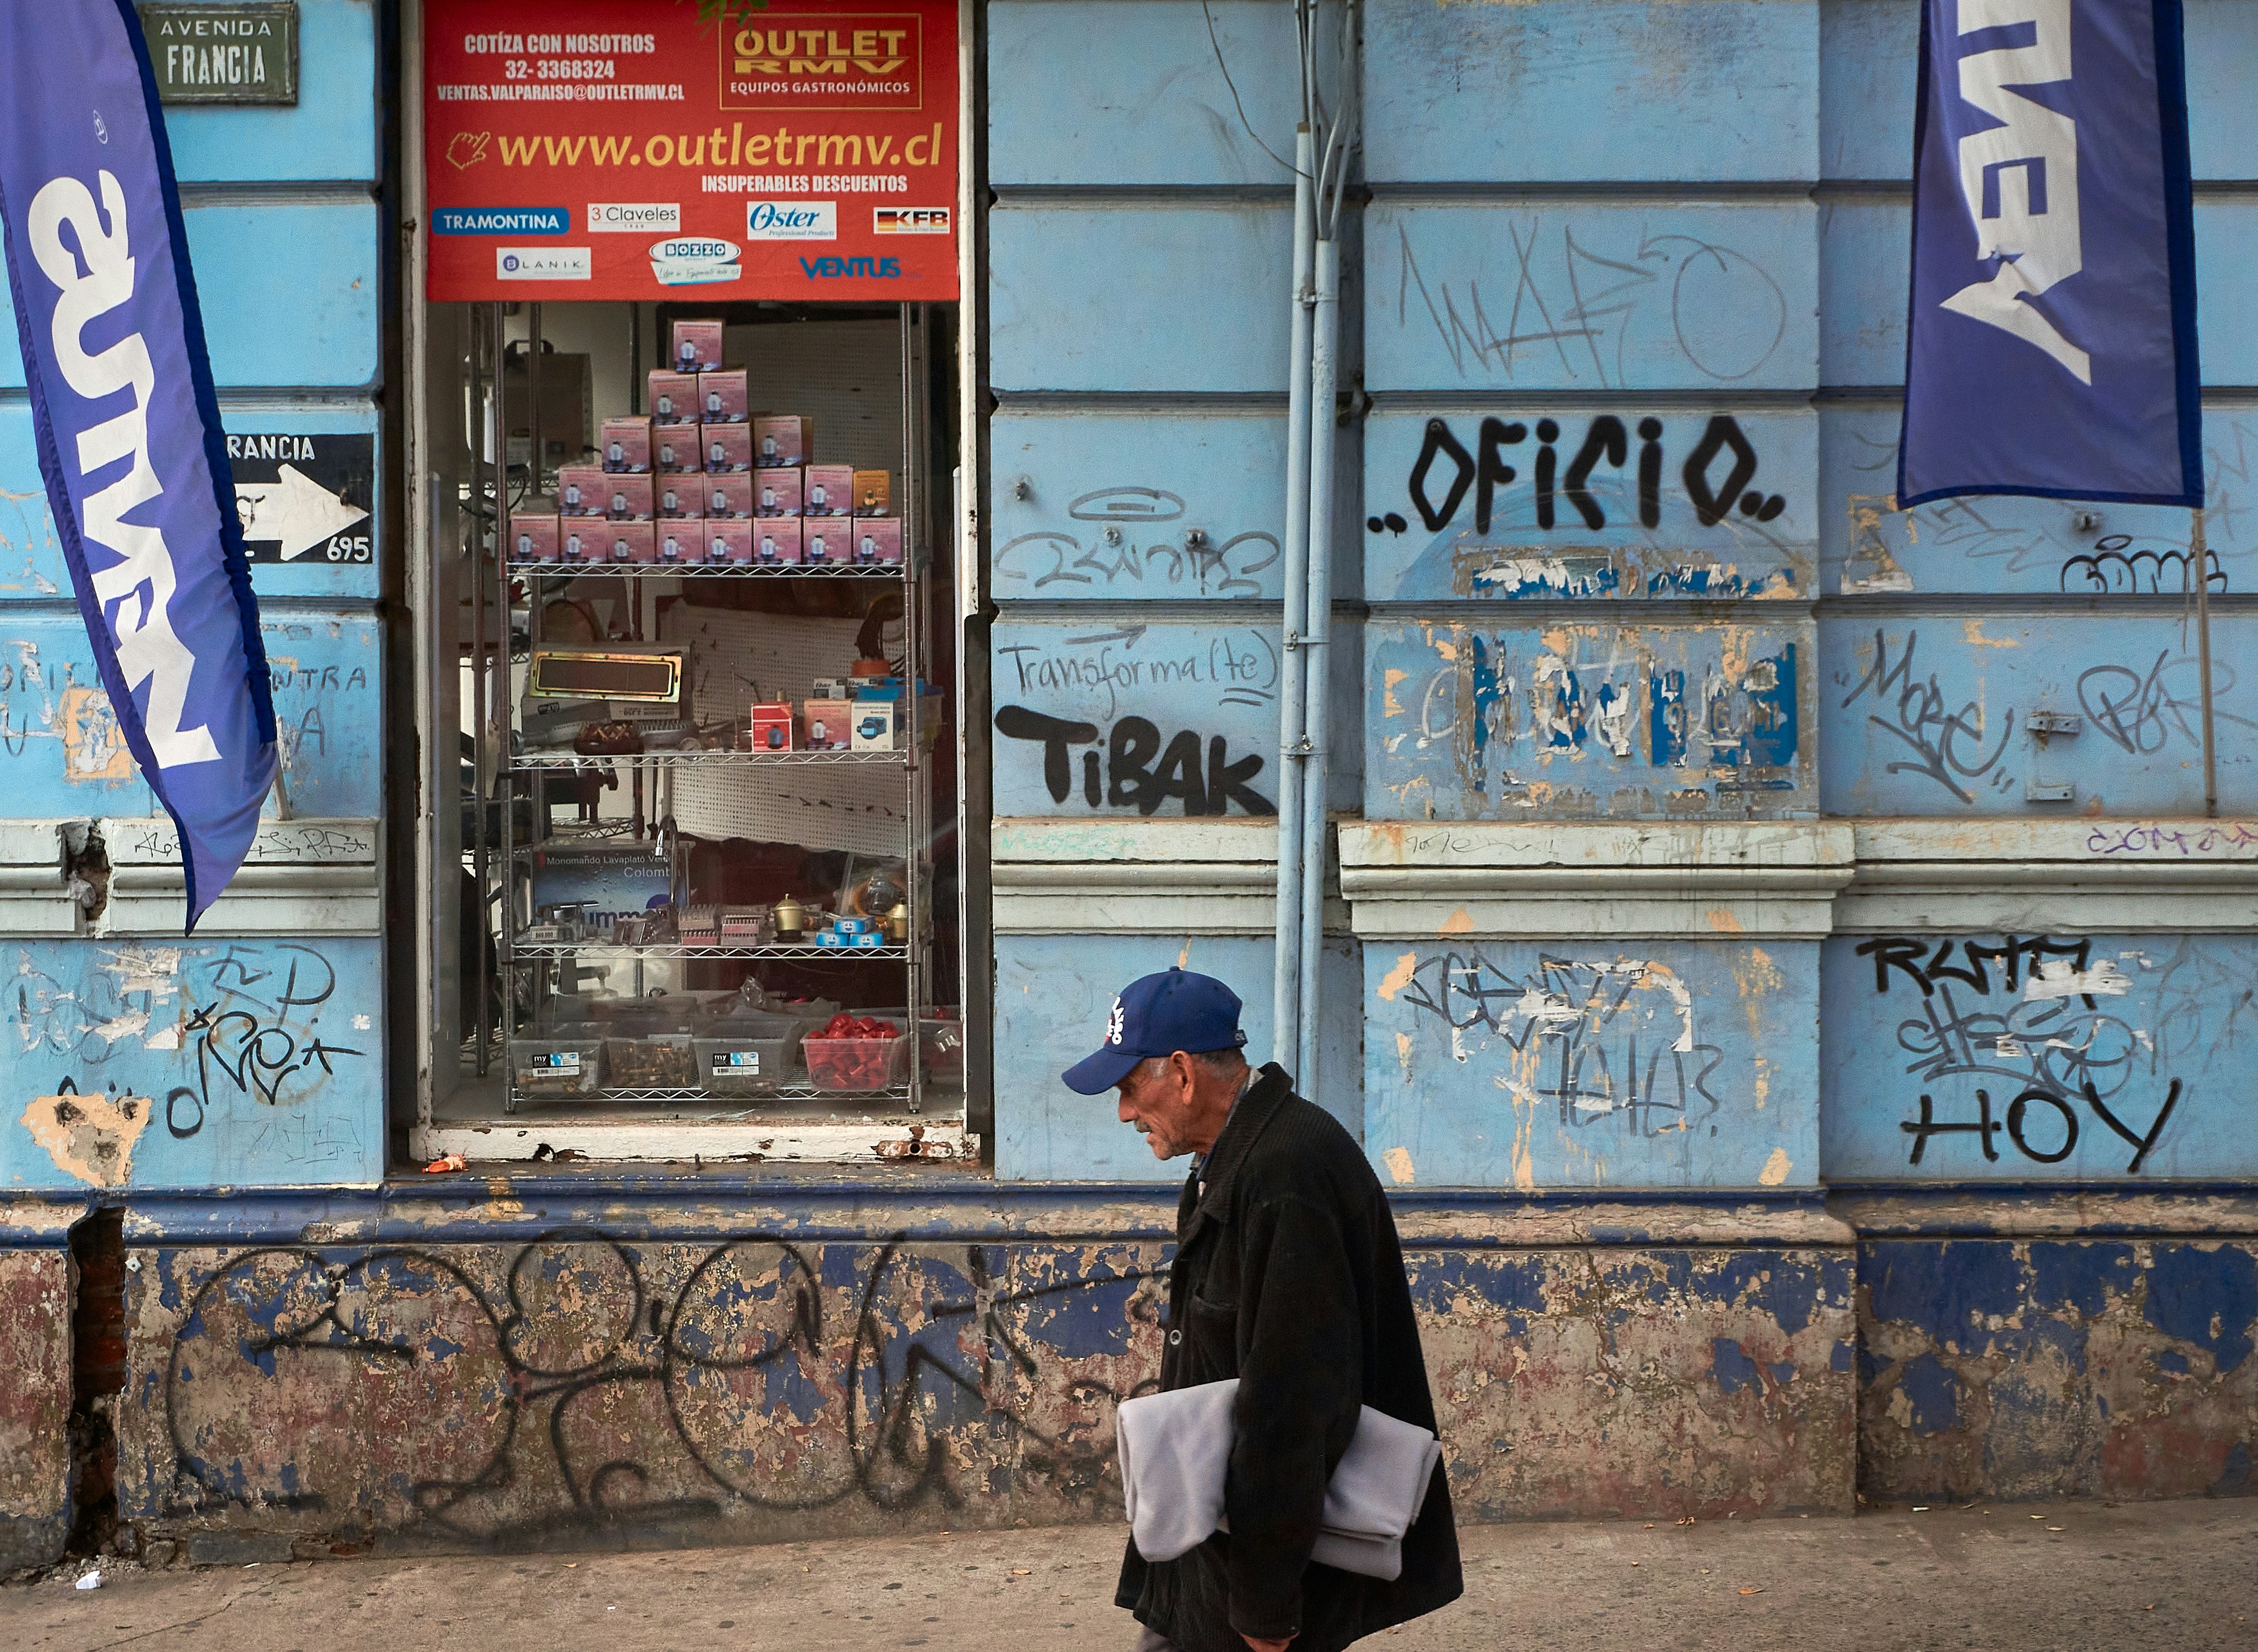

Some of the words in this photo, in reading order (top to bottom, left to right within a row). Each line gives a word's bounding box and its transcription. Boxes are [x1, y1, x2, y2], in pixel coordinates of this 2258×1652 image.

[161, 21, 272, 36] AVENIDA
[465, 31, 524, 54] COTÍZA
[527, 34, 562, 54] CON
[566, 34, 655, 54] NOSOTROS
[734, 30, 906, 56] OUTLET
[168, 45, 265, 85] FRANCIA
[537, 60, 615, 79] 3368324
[734, 59, 908, 74] RMV
[437, 84, 685, 101] VENTAS.VALPARAISO@OUTLETRMV.CL
[730, 82, 788, 95] EQUIPOS
[792, 79, 910, 93] GASTRONÓMICOS
[497, 122, 943, 166] www.outletrmv.cl
[702, 175, 809, 192] INSUPERABLES
[812, 175, 908, 192] DESCUENTOS
[443, 214, 560, 229] TRAMONTINA
[591, 207, 601, 221] 3
[606, 206, 677, 221] Claveles
[750, 203, 820, 231] Oster
[894, 211, 948, 226] KFB
[665, 243, 726, 256] BOZZO
[798, 257, 902, 282] VENTUS
[326, 537, 369, 561] 695
[1900, 1078, 2183, 1173] HOY
